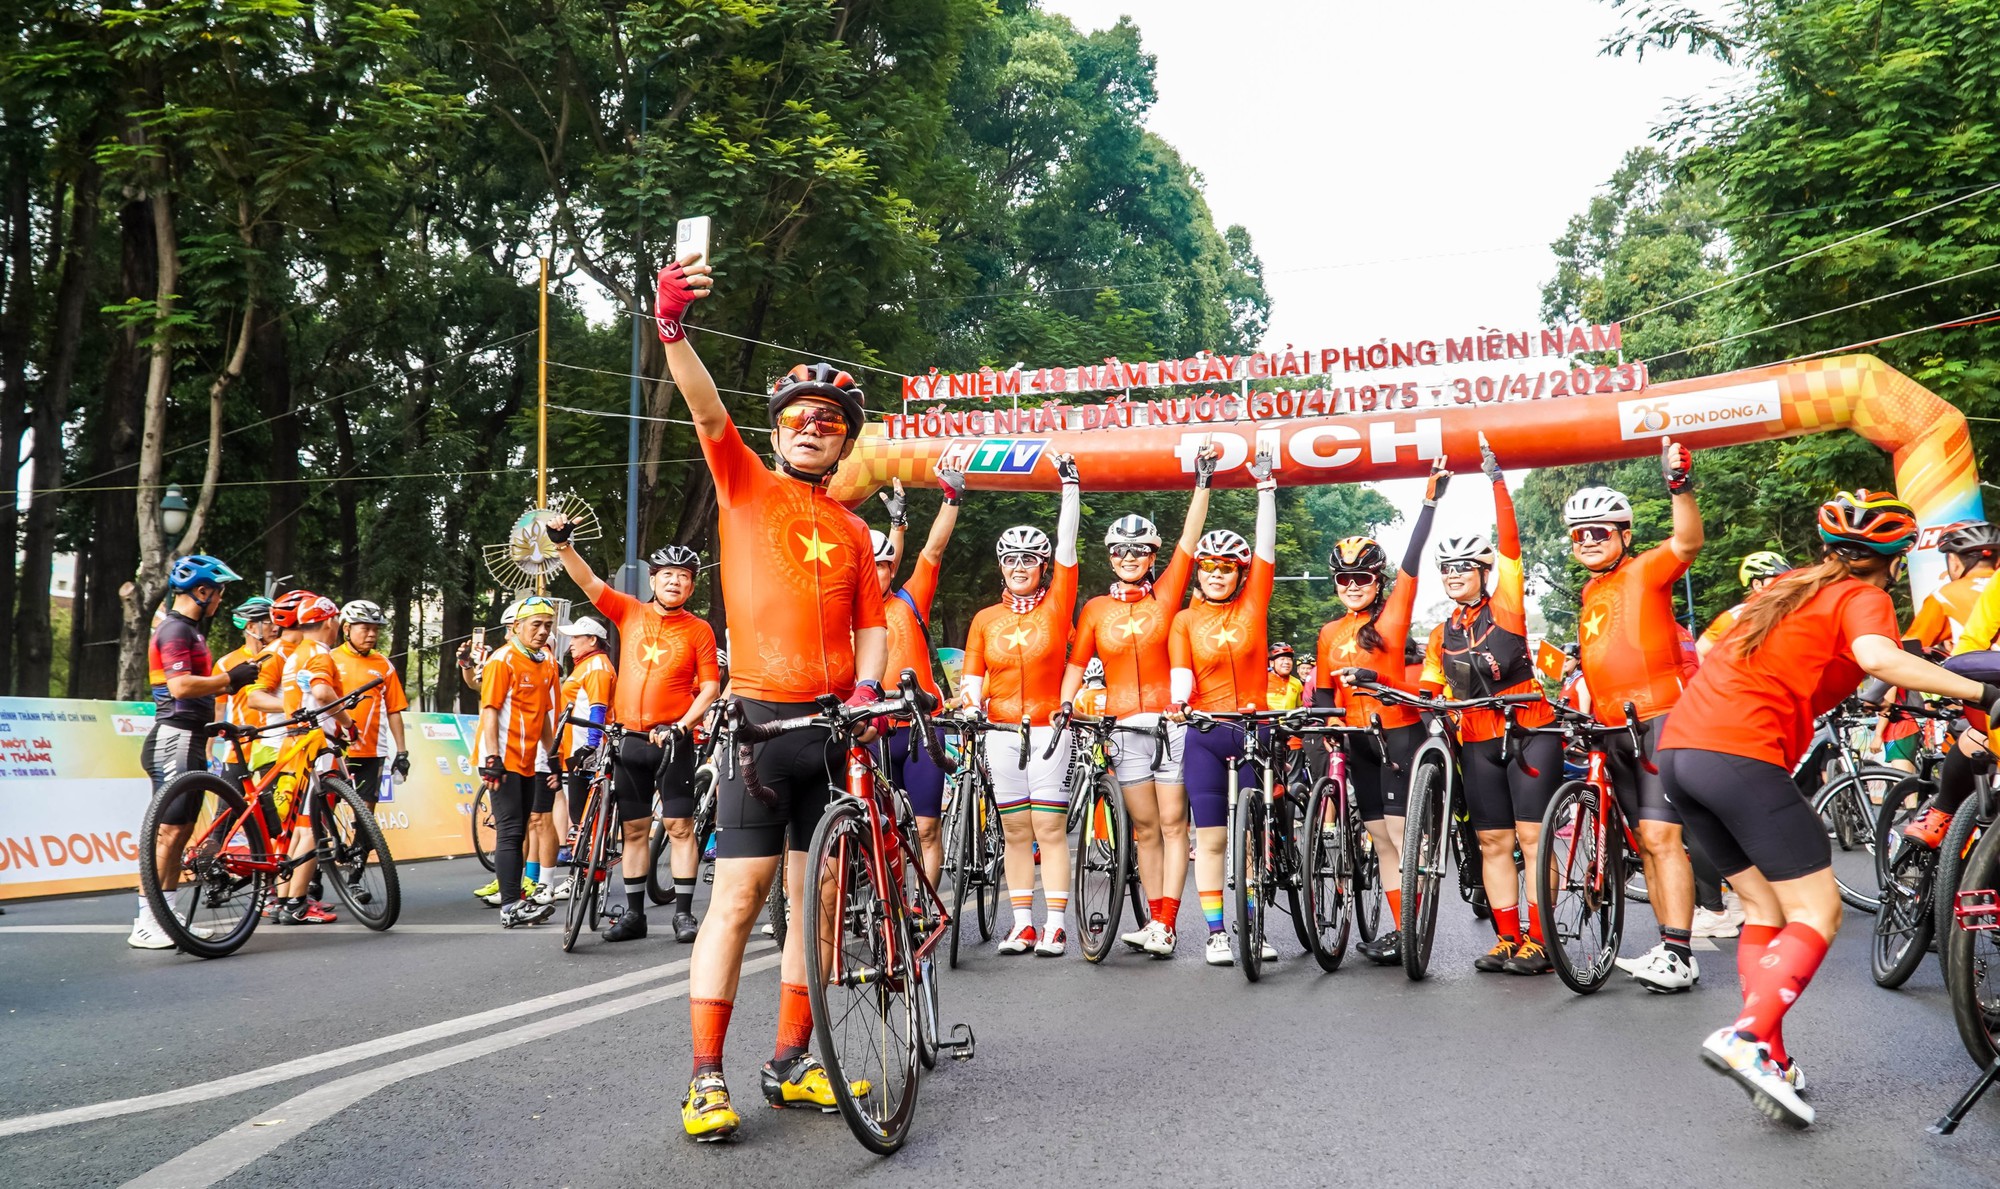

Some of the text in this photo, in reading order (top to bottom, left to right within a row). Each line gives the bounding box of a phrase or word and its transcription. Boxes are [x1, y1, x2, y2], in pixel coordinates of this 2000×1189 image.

[1031, 367, 1067, 393] 48
[1077, 356, 1148, 390] NĂM
[1248, 343, 1310, 379] GIẢI
[1541, 322, 1622, 356] NAM
[1246, 382, 1419, 423] (30/4/1975
[1453, 359, 1647, 404] 30/4/2023)
[1632, 402, 1768, 434] 25 TON DONG A
[944, 443, 1042, 468] HTV
[40, 831, 139, 867] DONG
